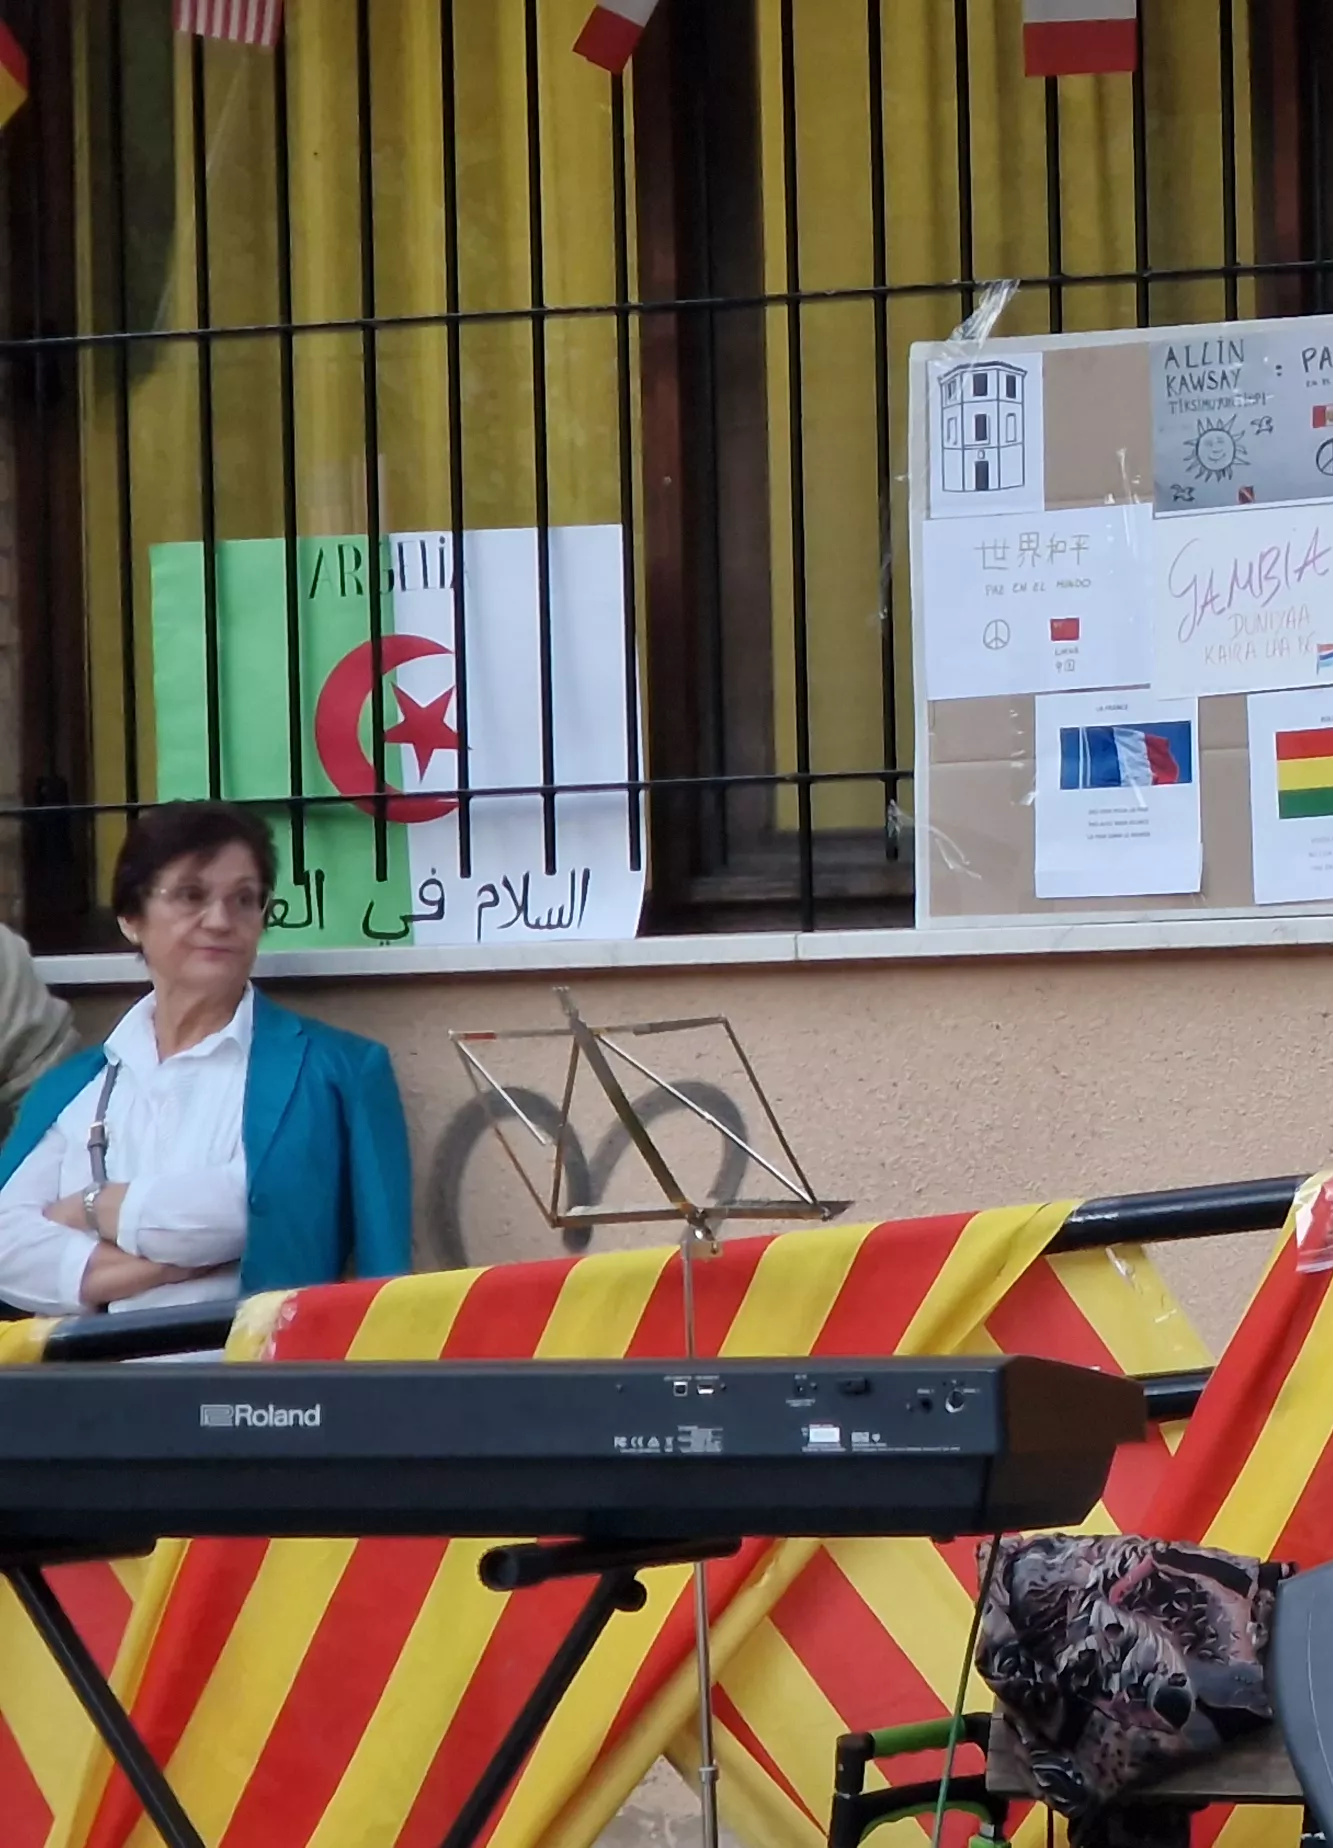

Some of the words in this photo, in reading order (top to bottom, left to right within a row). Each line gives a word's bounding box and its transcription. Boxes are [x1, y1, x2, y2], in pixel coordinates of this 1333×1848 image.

[1166, 368, 1242, 398] KAWSAY
[974, 532, 1091, 571] 世界和平
[1012, 581, 1028, 594] EN
[1032, 581, 1047, 593] EL
[1168, 526, 1333, 644] GAMBIA
[361, 867, 446, 947] في
[476, 867, 591, 943] السلام
[234, 1403, 321, 1428] Roland
